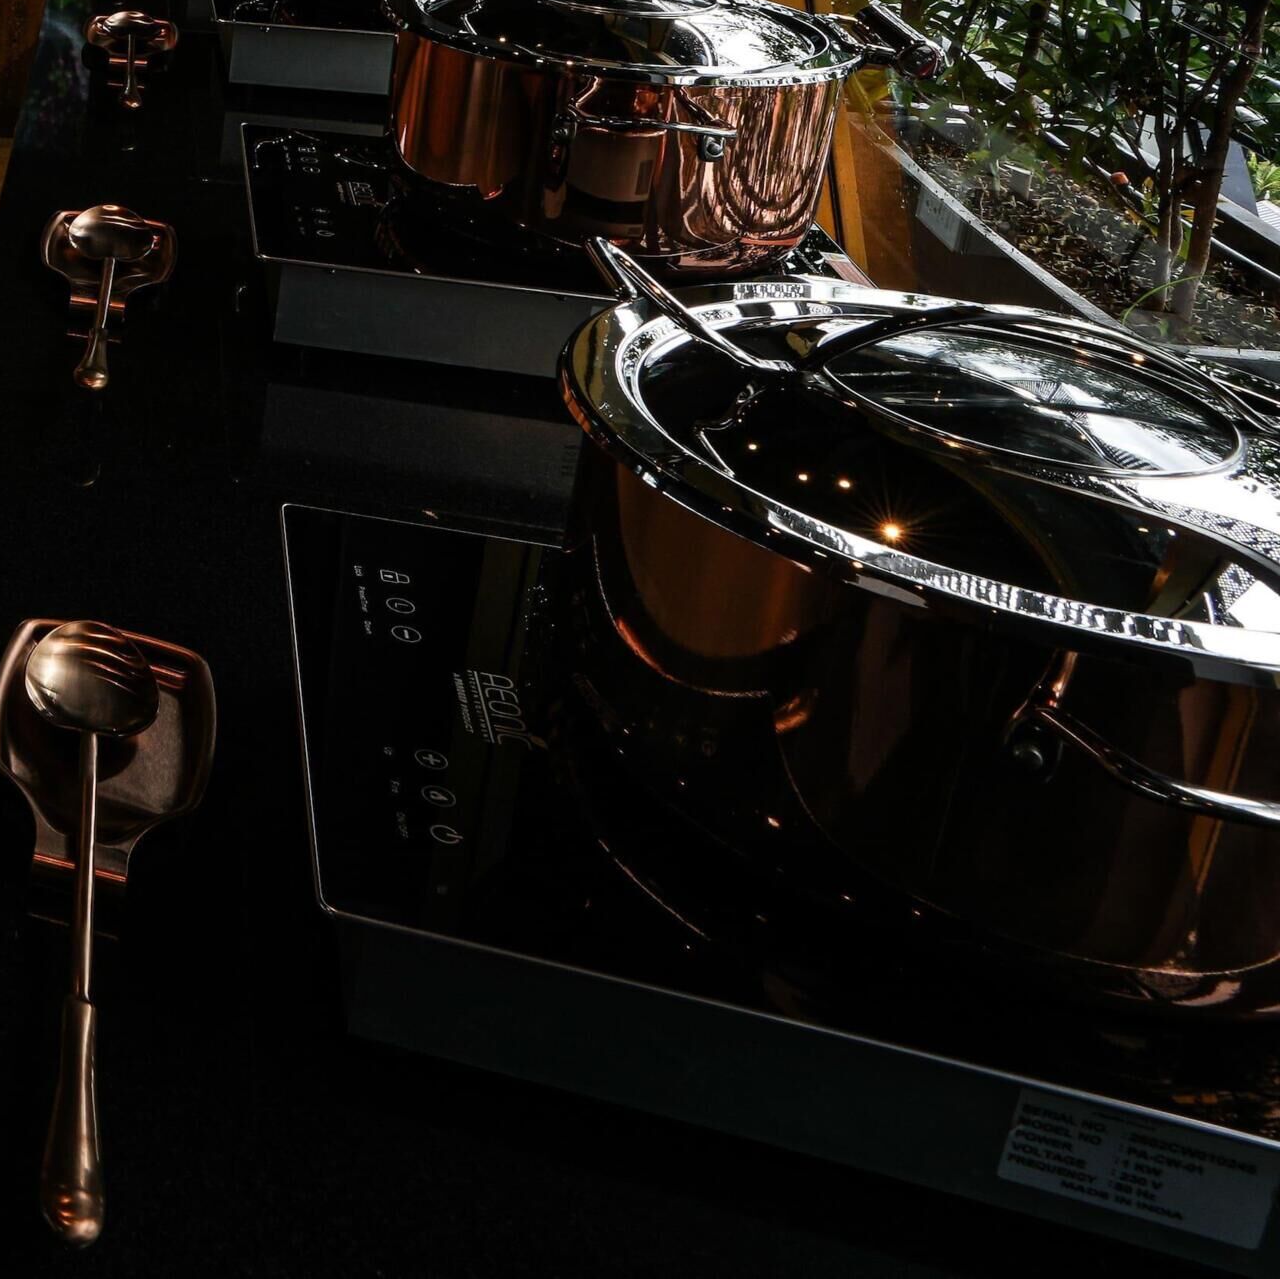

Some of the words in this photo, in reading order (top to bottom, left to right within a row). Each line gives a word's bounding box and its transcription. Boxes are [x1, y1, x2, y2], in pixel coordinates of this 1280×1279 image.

[1018, 1116, 1072, 1138] MODEL
[1022, 1103, 1078, 1126] SERIAL
[1015, 1129, 1073, 1152] POWER
[1007, 1152, 1097, 1183] FREQUENCY
[1011, 1141, 1088, 1169] VOLTAGE
[1060, 1180, 1109, 1200] MADE
[1115, 1195, 1133, 1206] IN
[1136, 1200, 1183, 1220] INDIA
